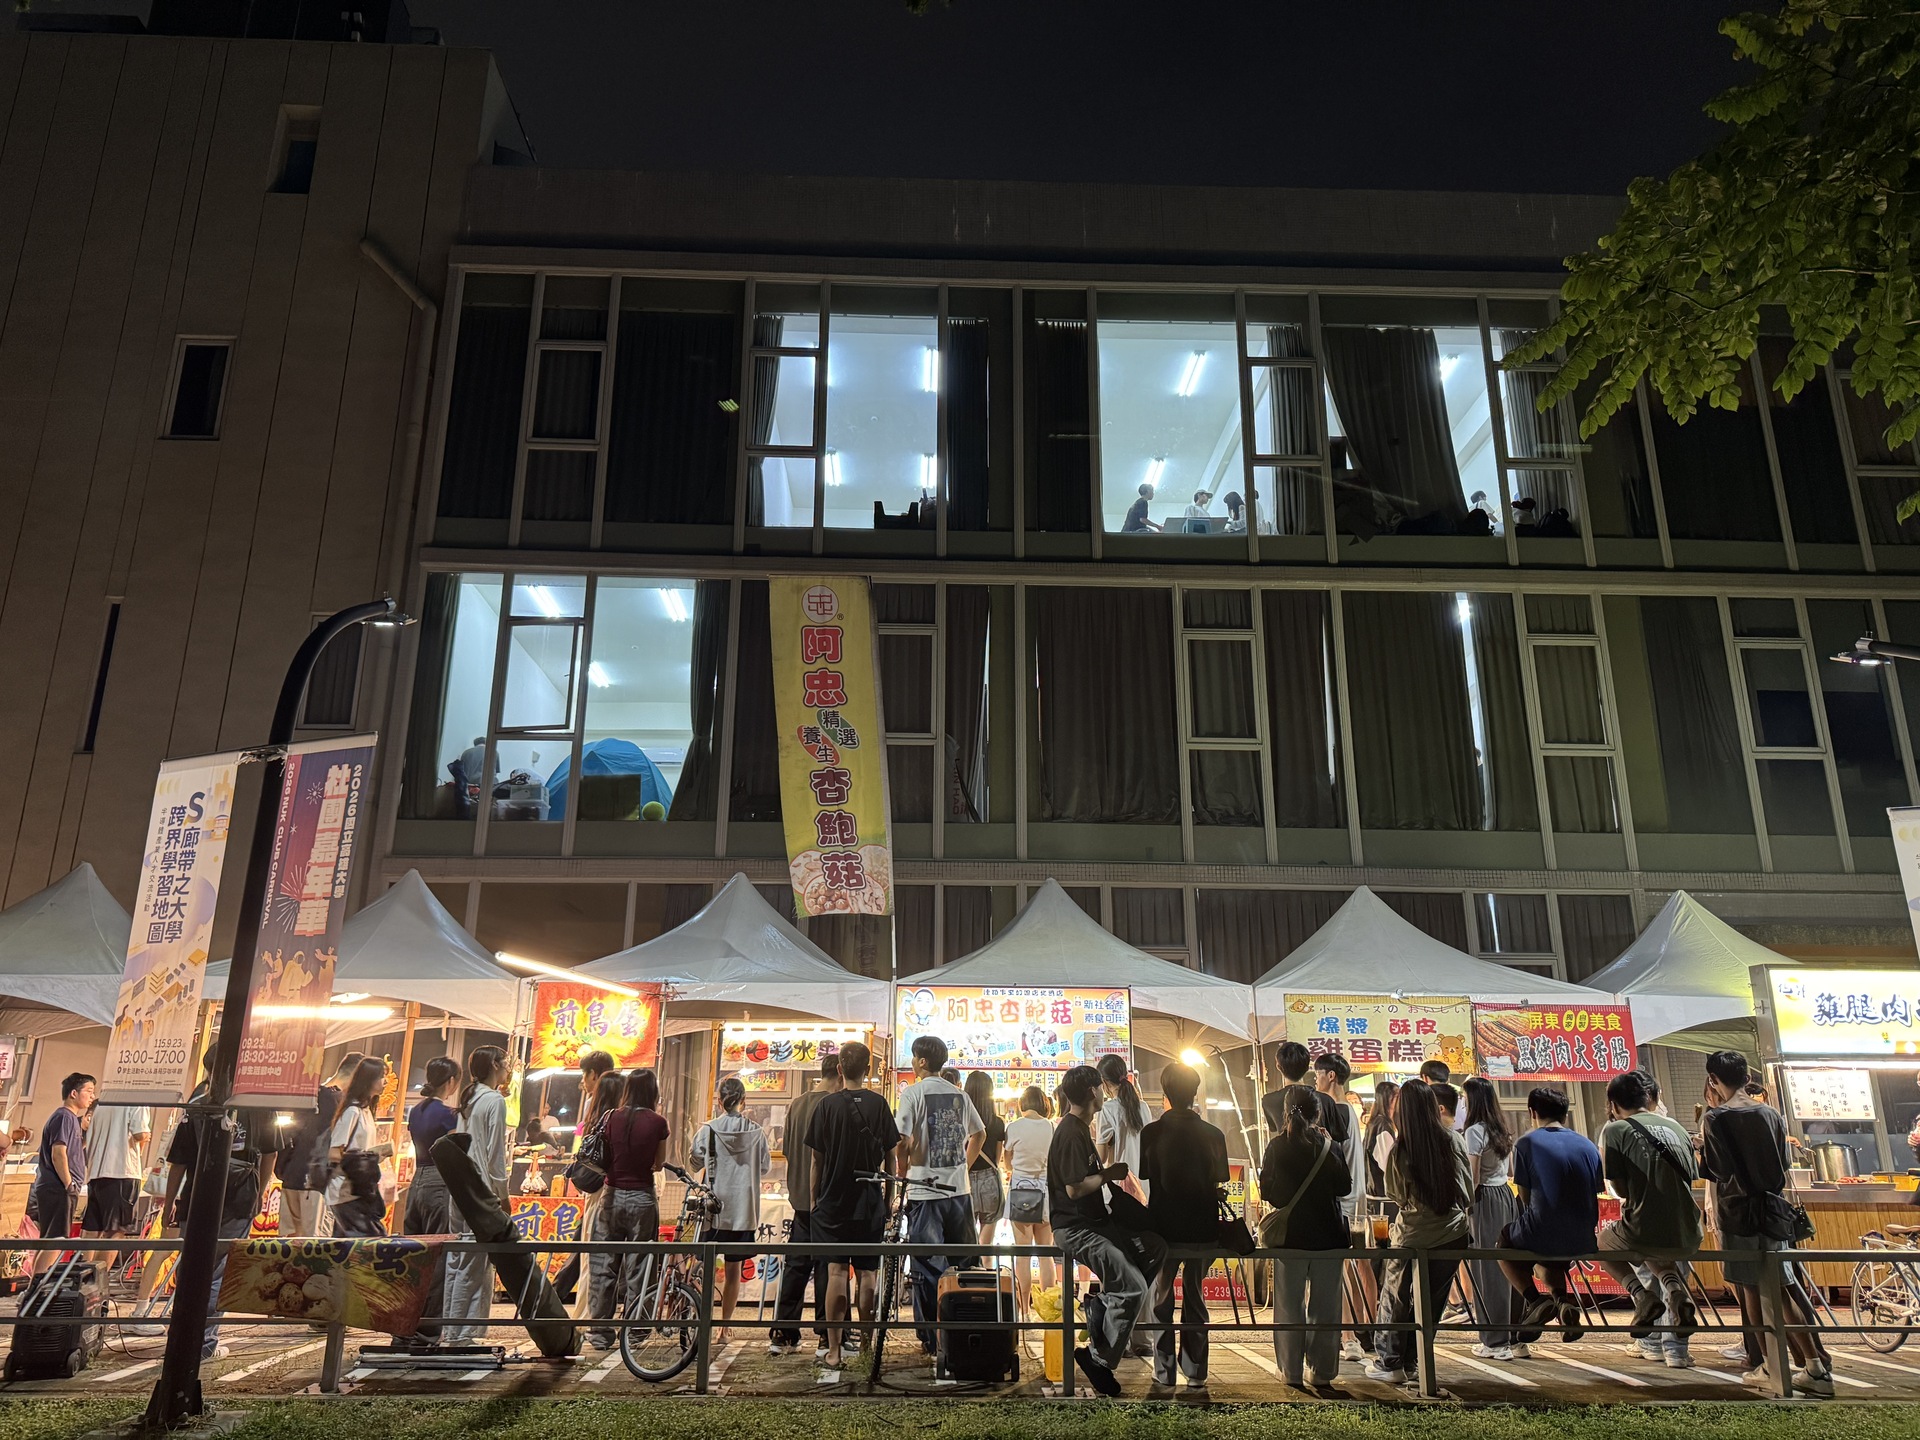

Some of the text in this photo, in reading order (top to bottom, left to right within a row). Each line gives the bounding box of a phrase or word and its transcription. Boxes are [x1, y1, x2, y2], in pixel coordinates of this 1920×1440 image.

[801, 625, 847, 707] 阿忠
[803, 726, 835, 763] 養生
[822, 710, 858, 747] 精選
[279, 797, 289, 823] NUK
[272, 827, 285, 861] CLUB
[810, 768, 866, 890] 杏鮑菇
[164, 791, 206, 944] S廊帶之大學
[294, 763, 351, 937] 社團嘉年華
[146, 804, 187, 944] 跨界學習地圖
[262, 862, 278, 930] CARNIVAL
[551, 999, 643, 1037] 煎鳥蛋
[947, 998, 1073, 1025] 阿忠杏鮑菇
[1388, 1017, 1438, 1036] 酥皮
[1528, 1012, 1561, 1031] 屏東
[1589, 1012, 1623, 1031] 美食
[1813, 992, 1920, 1028] 雞腿肉
[118, 1049, 186, 1064] 13:00-17:00
[240, 1050, 298, 1064] 18:30-21:30
[745, 1039, 845, 1062] 七彩水果
[944, 1058, 1011, 1067] 用天然高級食材
[1515, 1033, 1631, 1072] 黑豬肉大香腸
